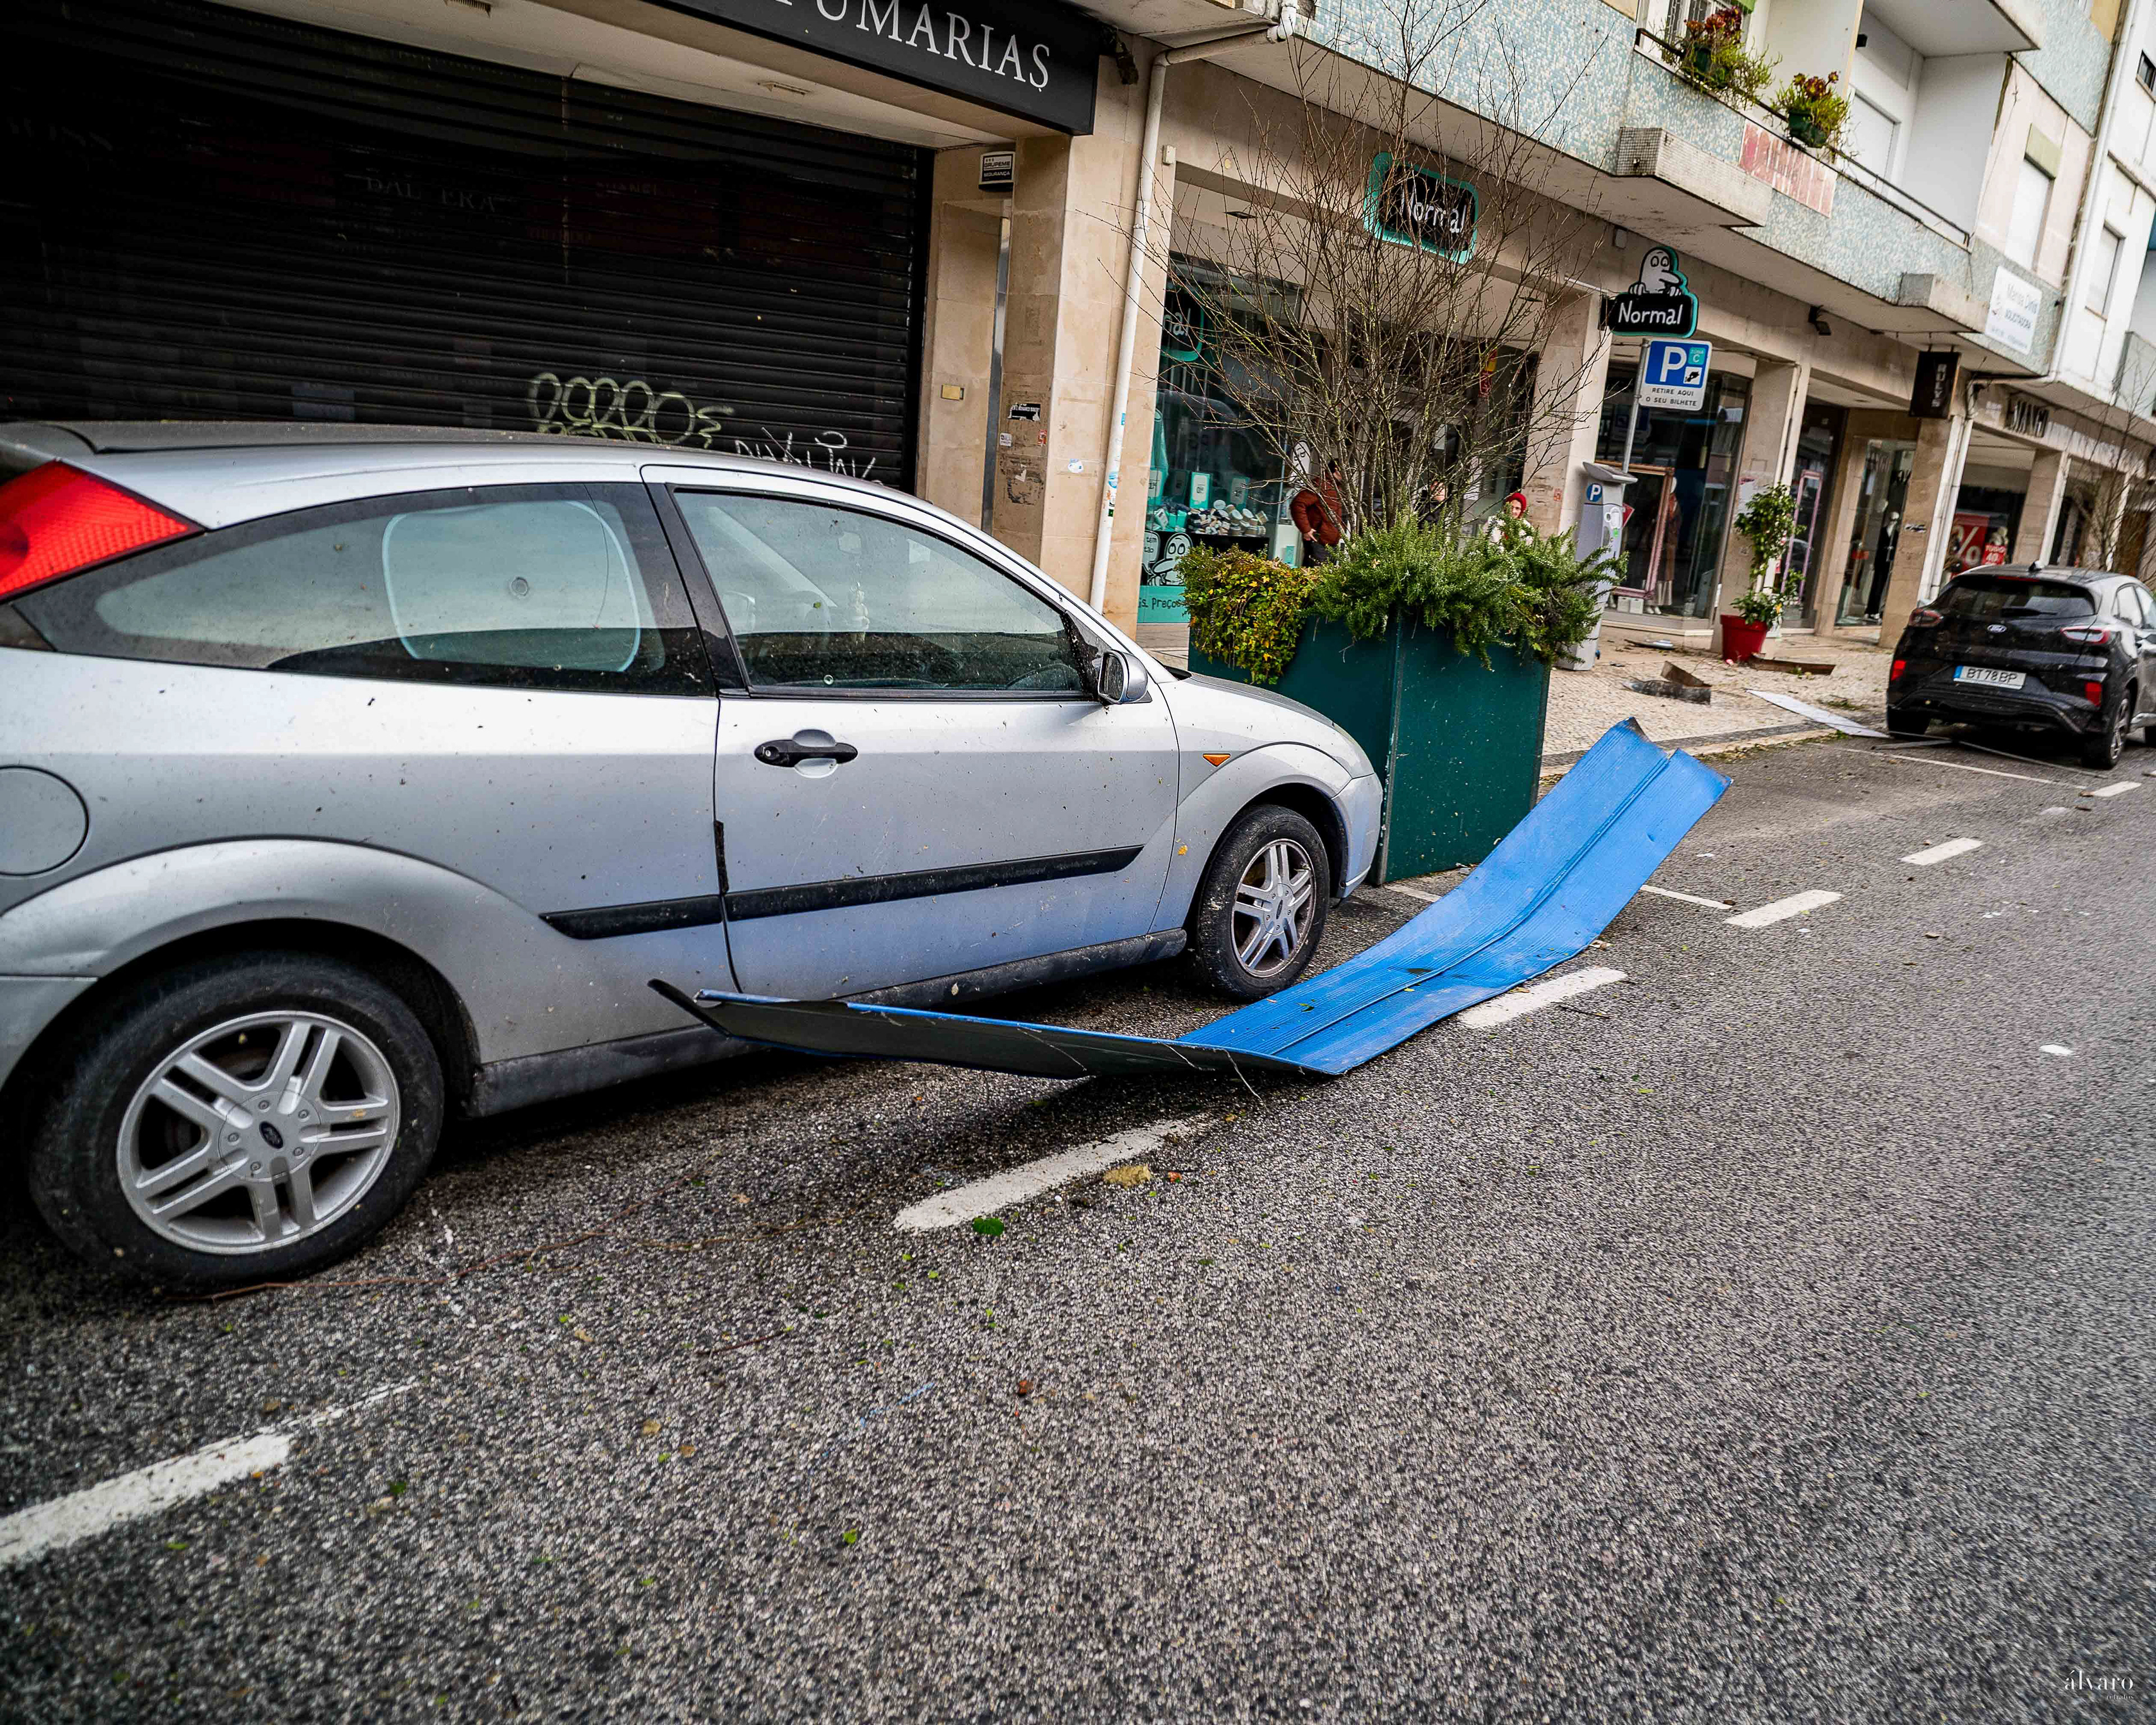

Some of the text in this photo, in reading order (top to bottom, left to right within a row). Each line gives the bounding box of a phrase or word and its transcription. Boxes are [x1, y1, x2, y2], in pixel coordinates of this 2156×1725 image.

[1618, 300, 1683, 325] Normal
[1659, 346, 1687, 382] P
[1693, 354, 1700, 363] C
[1670, 398, 1697, 407] BILHETE
[1589, 484, 1601, 500] P
[1985, 670, 1998, 681] 78
[1999, 672, 2018, 684] BP
